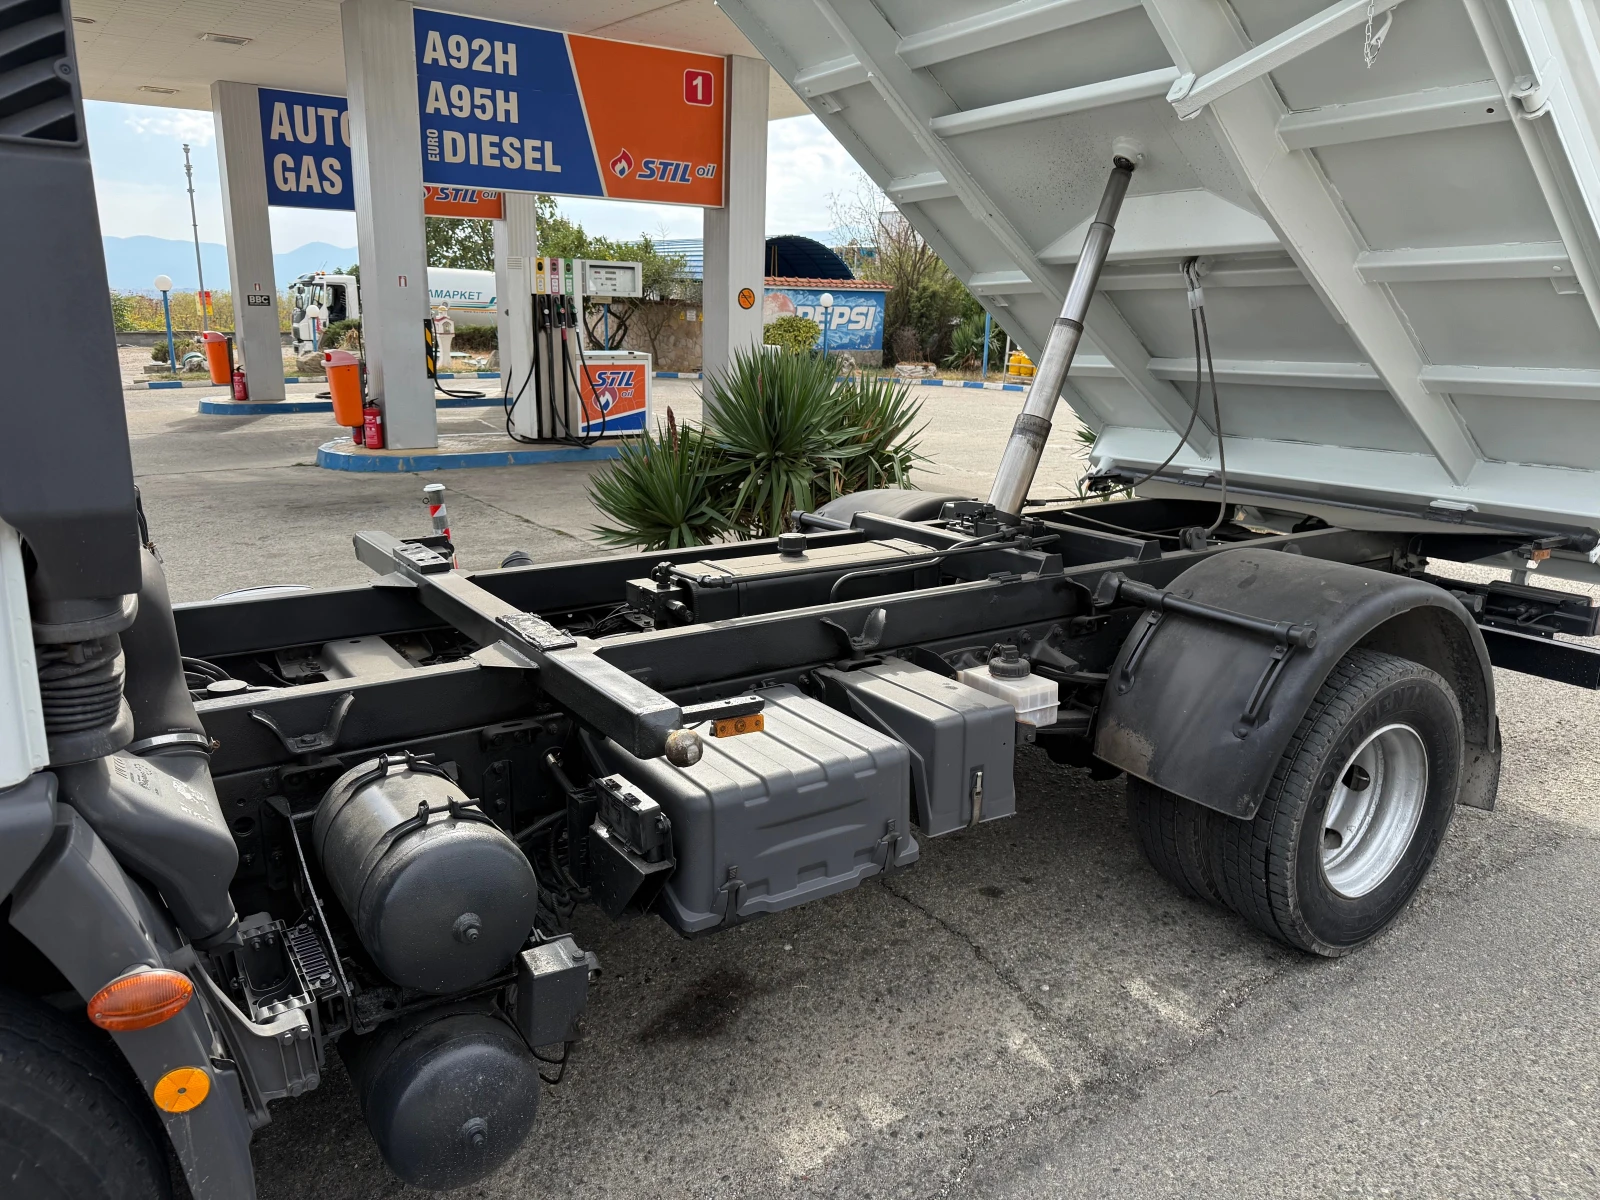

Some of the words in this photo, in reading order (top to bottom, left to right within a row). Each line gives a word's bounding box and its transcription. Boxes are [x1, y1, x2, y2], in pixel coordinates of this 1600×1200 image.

[423, 30, 518, 76] A92H
[425, 80, 519, 124] A95H
[692, 75, 703, 100] 1
[426, 129, 440, 162] EURO
[443, 130, 562, 173] DIESEL
[273, 153, 343, 195] GAS
[636, 158, 692, 184] STIL
[696, 163, 717, 179] oil
[434, 187, 479, 204] STIL
[591, 371, 635, 387] STIL
[621, 389, 634, 398] oil
